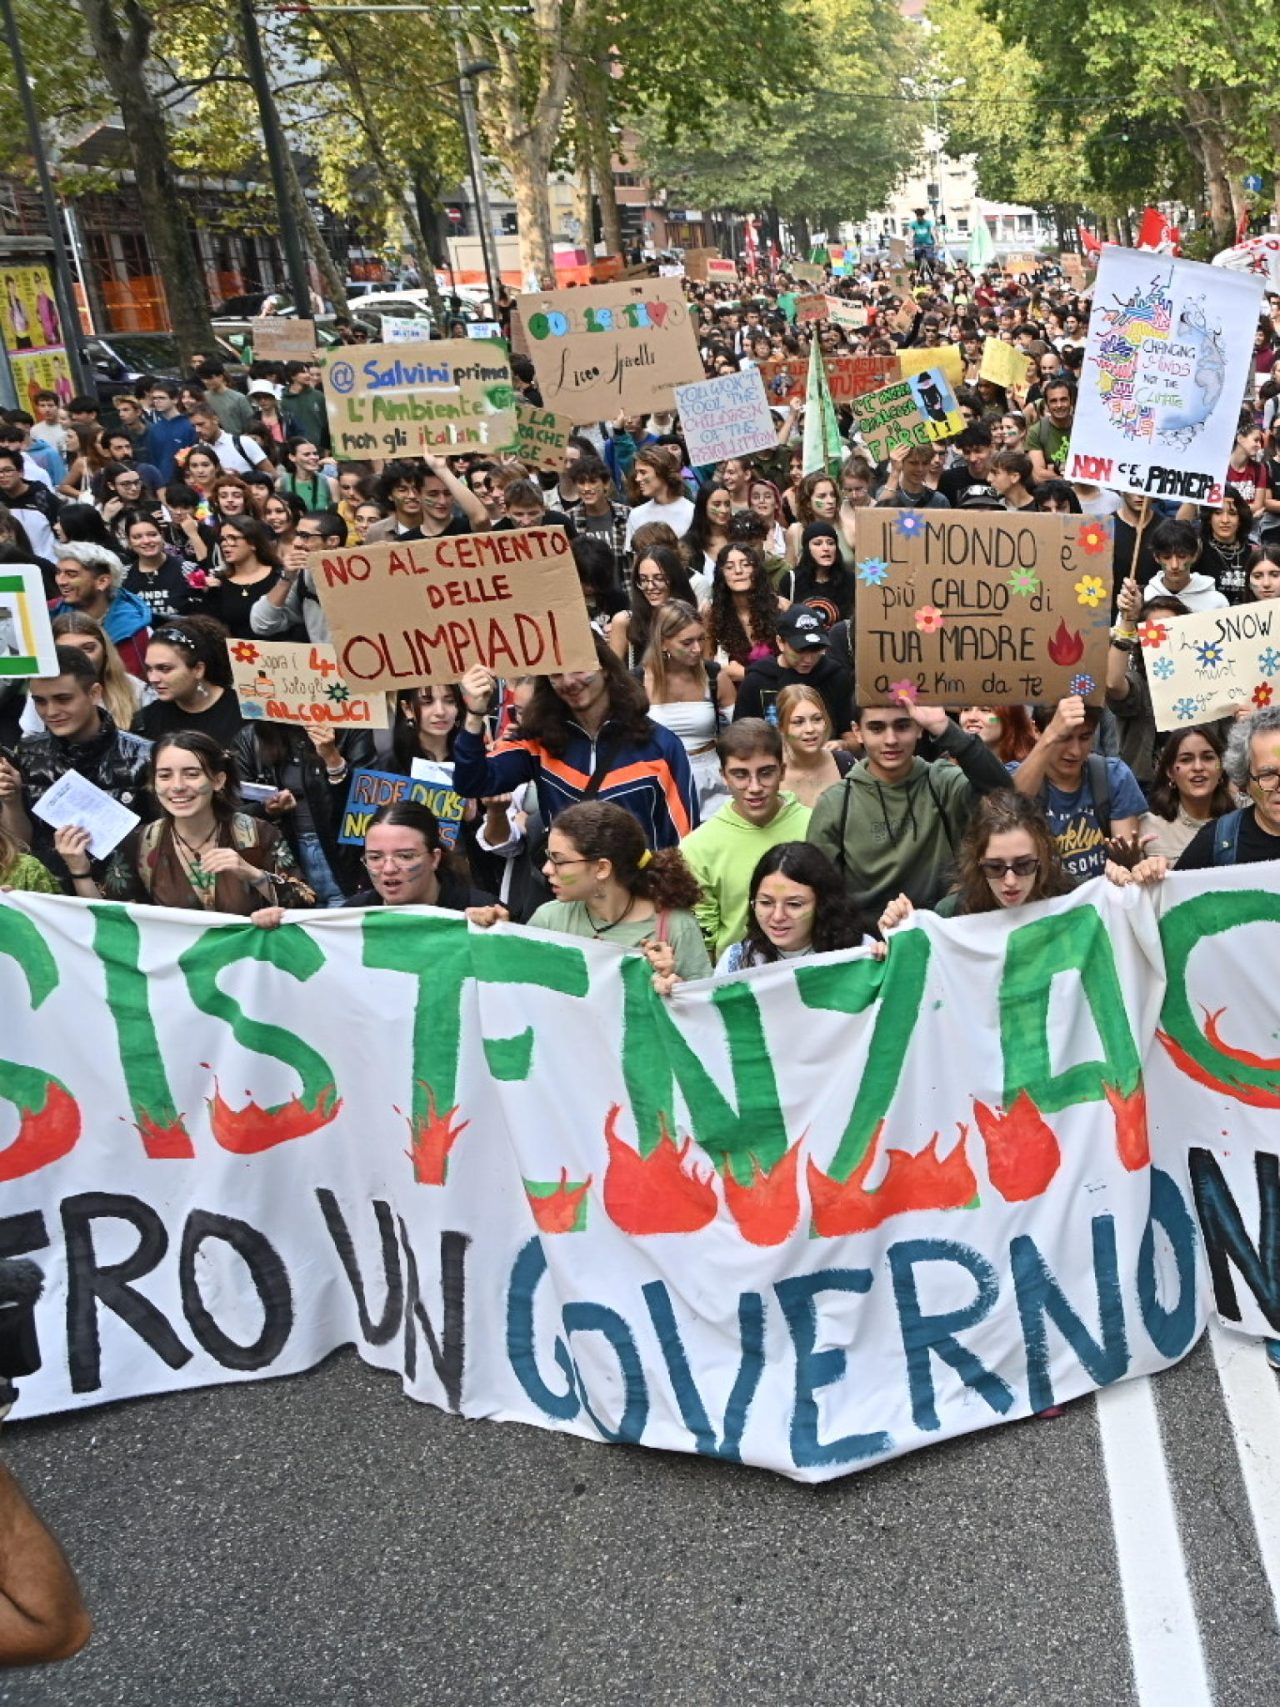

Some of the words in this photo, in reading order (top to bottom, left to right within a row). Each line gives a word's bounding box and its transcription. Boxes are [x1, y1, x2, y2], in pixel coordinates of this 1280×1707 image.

[1142, 338, 1196, 360] CHANGING
[329, 361, 355, 394] @
[362, 359, 450, 389] Salvini
[453, 362, 509, 385] prima
[1142, 373, 1159, 388] NOT
[346, 394, 484, 423] L'Ambiente
[676, 387, 710, 404] YOU
[727, 386, 760, 406] THE
[528, 410, 556, 429] LA
[683, 402, 764, 432] CHILDREN
[700, 428, 723, 444] OF
[724, 420, 760, 437] THE
[341, 431, 378, 451] non
[381, 427, 408, 455] gli
[417, 421, 489, 448] italiani
[1071, 453, 1115, 483] NON
[1143, 465, 1215, 502] PIANETA
[1206, 482, 1224, 504] B
[321, 554, 371, 588] NO
[388, 548, 430, 577] AL
[435, 531, 570, 569] CEMENTO
[882, 521, 908, 565] IL
[924, 521, 1038, 569] MONDO
[426, 574, 514, 610] DELLE
[881, 575, 916, 620] più
[931, 577, 1009, 609] CALDO
[1029, 579, 1053, 613] di
[1213, 610, 1274, 646] SNOW
[342, 609, 563, 680] OLIMPIADI
[867, 629, 924, 664] TUA
[938, 624, 1037, 663] MADRE
[260, 652, 289, 670] Sopra
[308, 647, 344, 678] 4
[1193, 658, 1238, 681] must
[874, 673, 893, 693] a
[916, 672, 931, 694] 2
[981, 672, 1011, 694] da
[1018, 673, 1043, 697] te
[1195, 688, 1219, 711] go
[355, 775, 408, 806] RIDE
[411, 783, 464, 821] DICKS
[314, 1187, 472, 1414] UN
[506, 1164, 1205, 1468] GOVERNO
